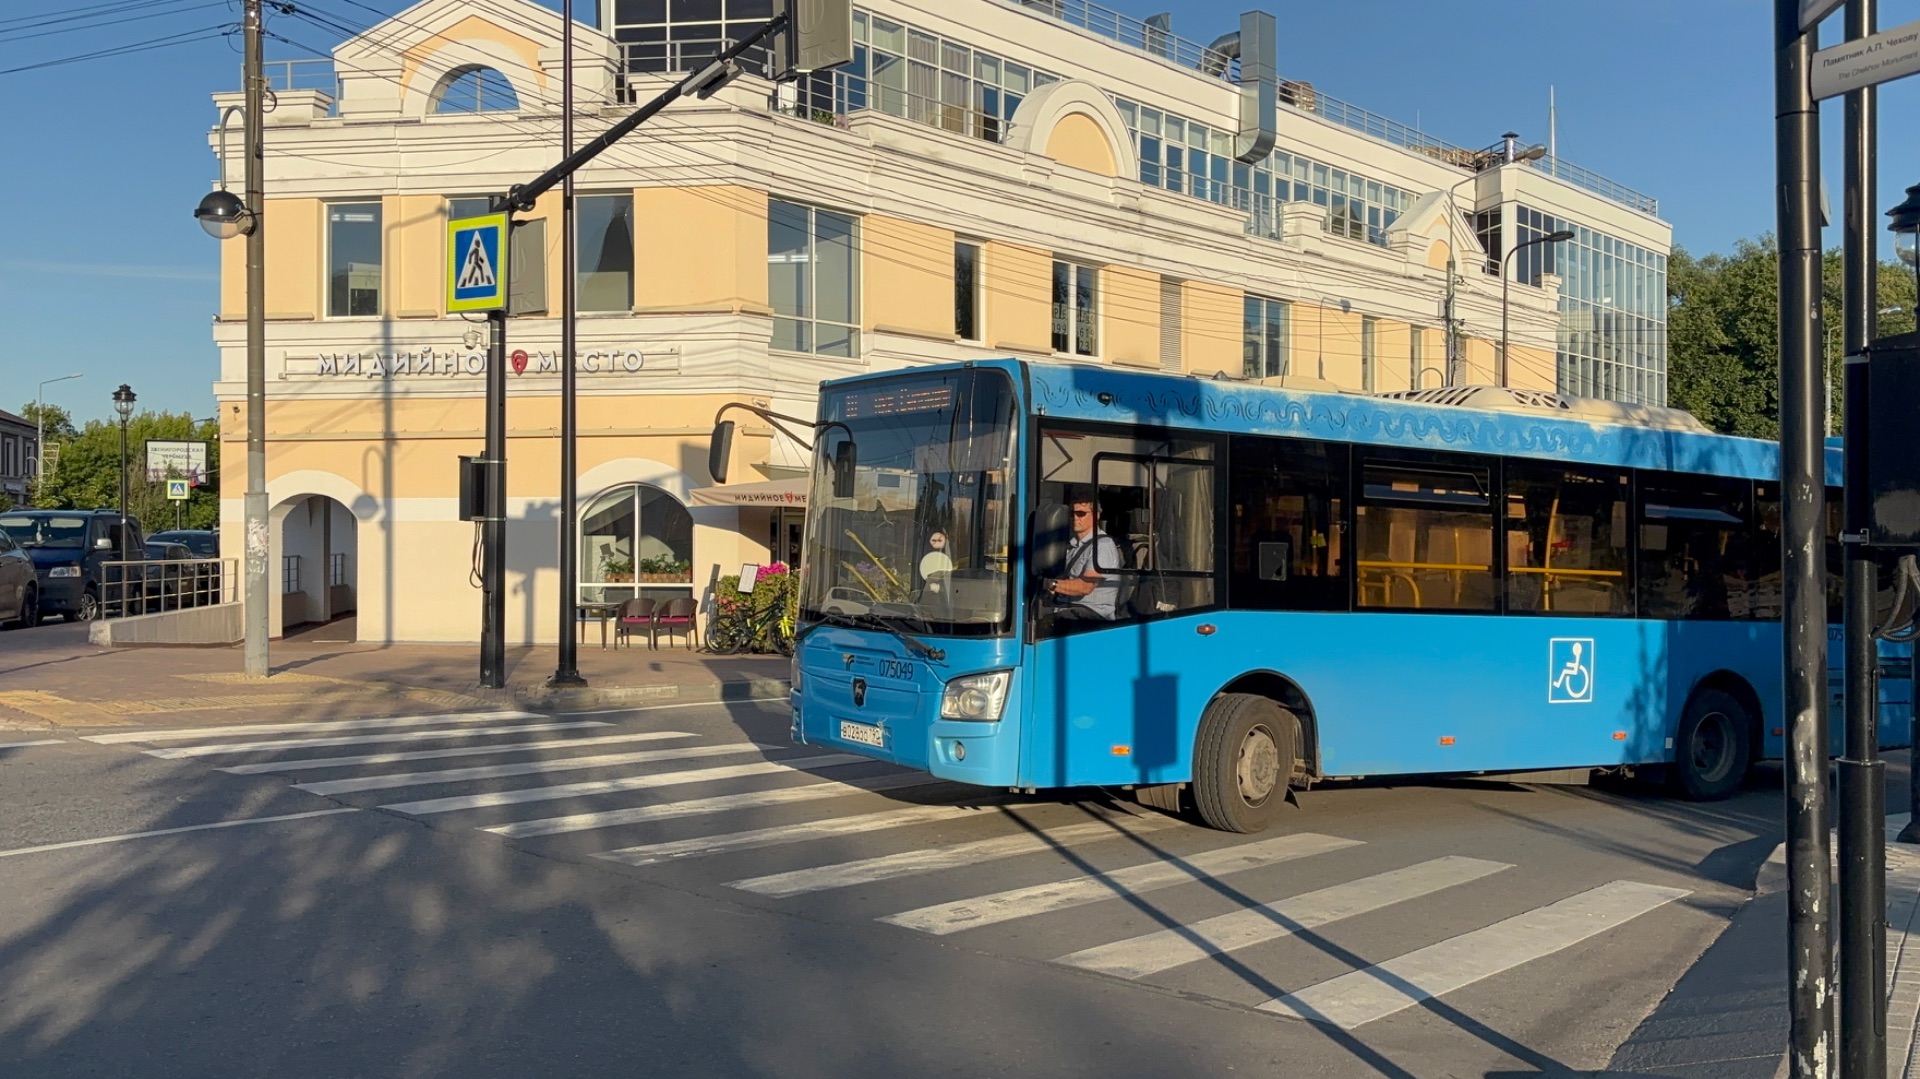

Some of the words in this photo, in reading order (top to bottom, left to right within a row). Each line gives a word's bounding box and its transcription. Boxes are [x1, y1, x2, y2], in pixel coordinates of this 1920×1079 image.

[1823, 50, 1864, 67] Памятник
[1866, 42, 1884, 54] А.П.
[1886, 32, 1919, 47] Чехову
[1838, 71, 1850, 80] The
[1851, 62, 1880, 77] Chekhov
[1882, 51, 1919, 67] Monument
[316, 346, 487, 378] МИДИЙНО
[536, 349, 644, 375] МСТО
[734, 493, 784, 502] МИДИЙНОЕ
[879, 659, 914, 680] 075049
